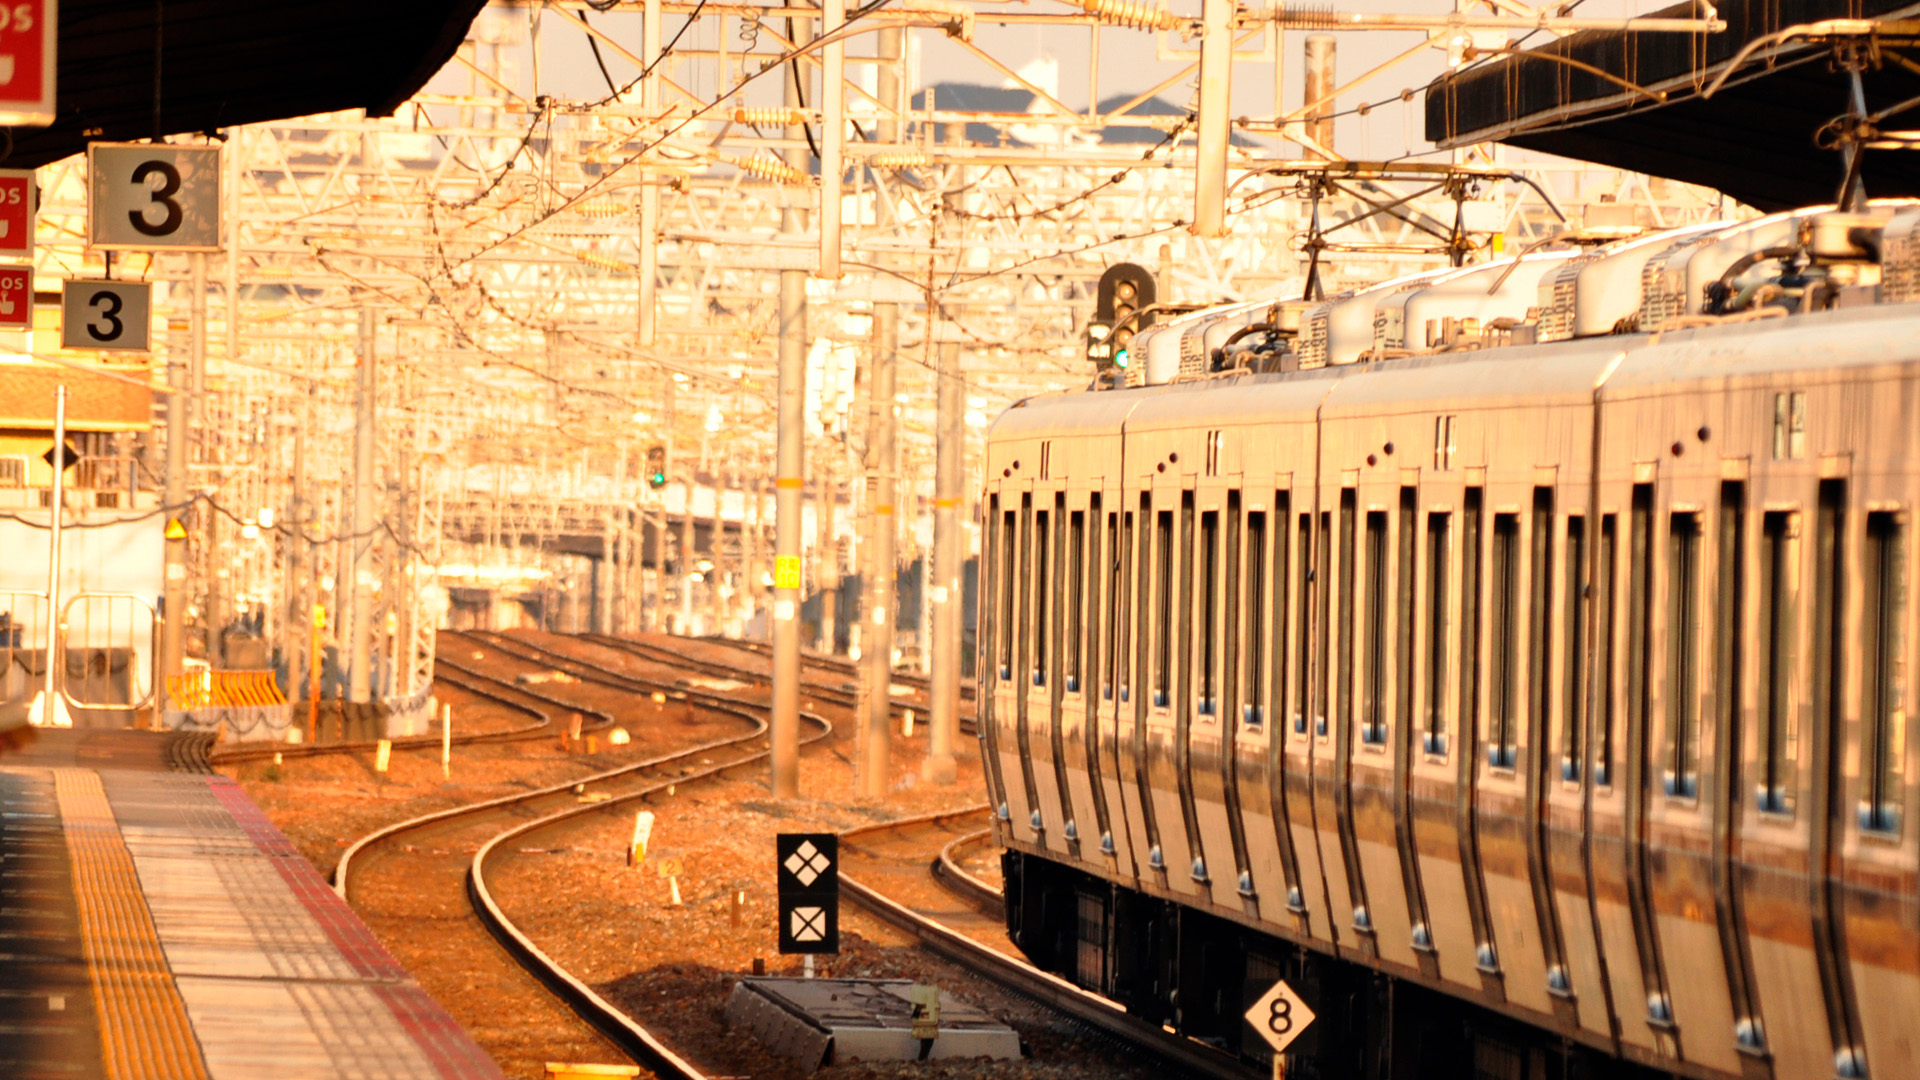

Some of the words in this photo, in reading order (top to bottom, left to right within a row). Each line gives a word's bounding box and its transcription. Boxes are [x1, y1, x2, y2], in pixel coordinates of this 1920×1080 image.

[128, 160, 183, 236] 3
[86, 290, 123, 341] 3
[664, 860, 676, 874] 2
[1268, 998, 1292, 1034] 8
